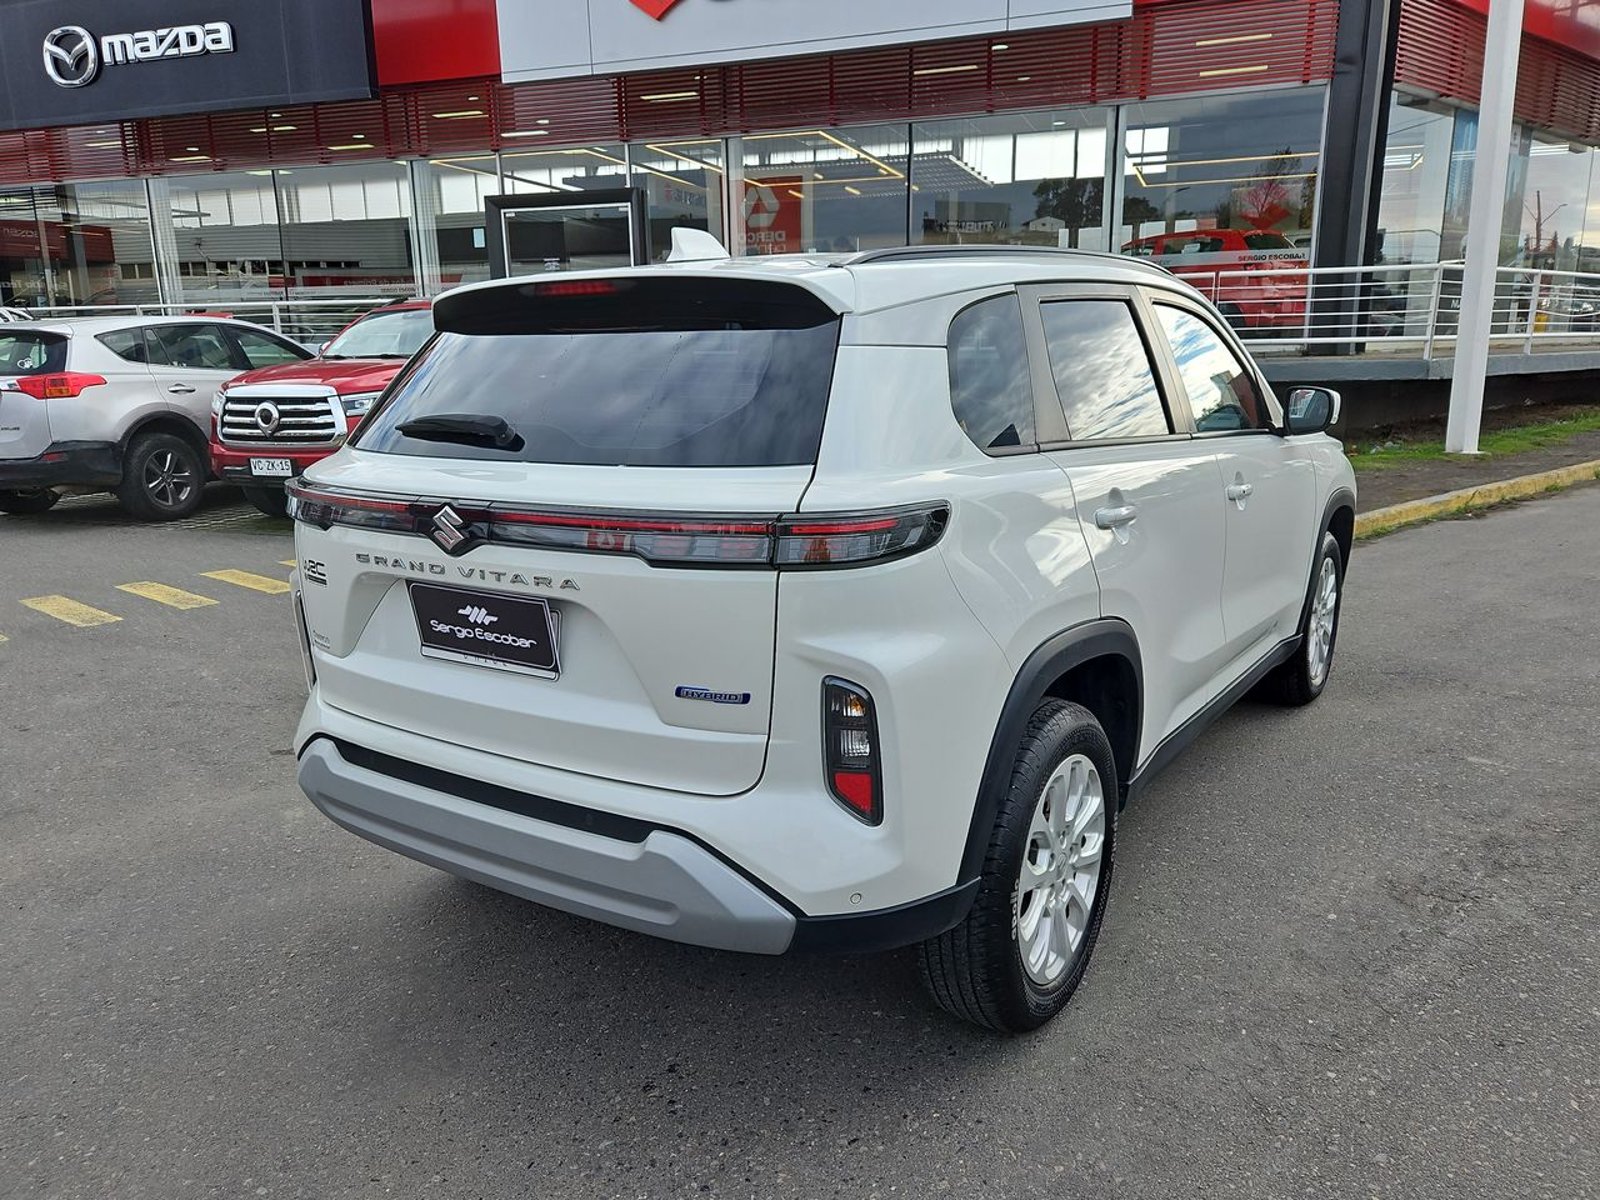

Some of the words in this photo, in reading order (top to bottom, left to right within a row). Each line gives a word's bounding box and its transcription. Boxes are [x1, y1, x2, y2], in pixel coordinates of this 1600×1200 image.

[101, 21, 234, 66] mazda
[1238, 254, 1267, 262] SERGIO
[355, 553, 446, 576] GRAND
[457, 566, 580, 591] VITARA
[474, 627, 537, 648] Escobar
[682, 689, 741, 702] HYBRID
